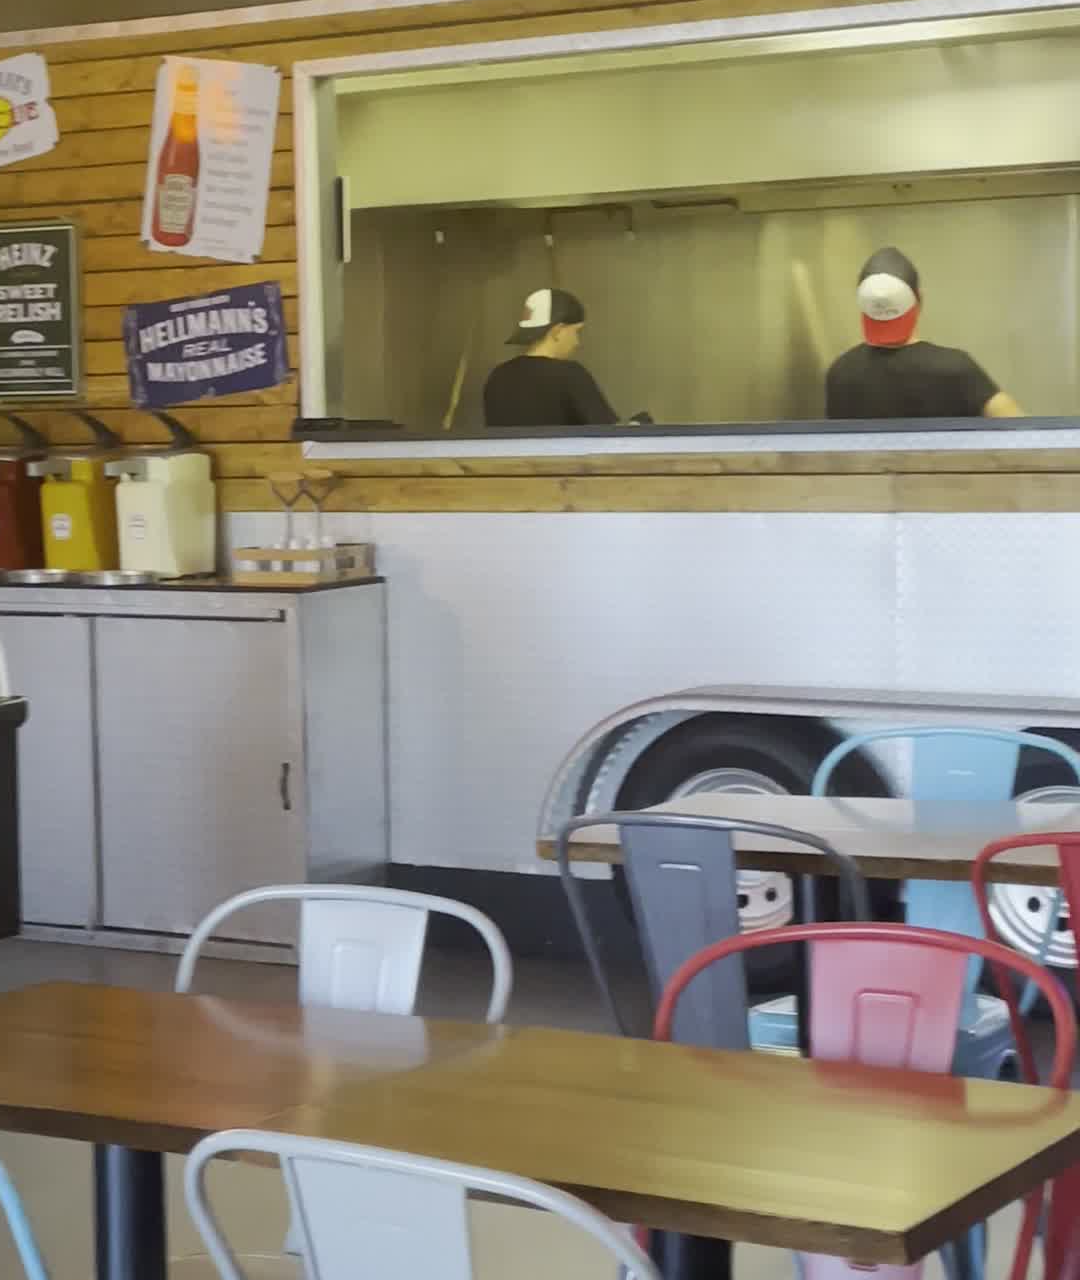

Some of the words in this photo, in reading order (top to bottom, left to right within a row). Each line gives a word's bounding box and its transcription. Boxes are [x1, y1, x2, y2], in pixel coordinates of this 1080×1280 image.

[139, 300, 269, 354] HELLMANN'S
[146, 342, 268, 383] MAYONNAISE
[181, 337, 233, 359] REAL
